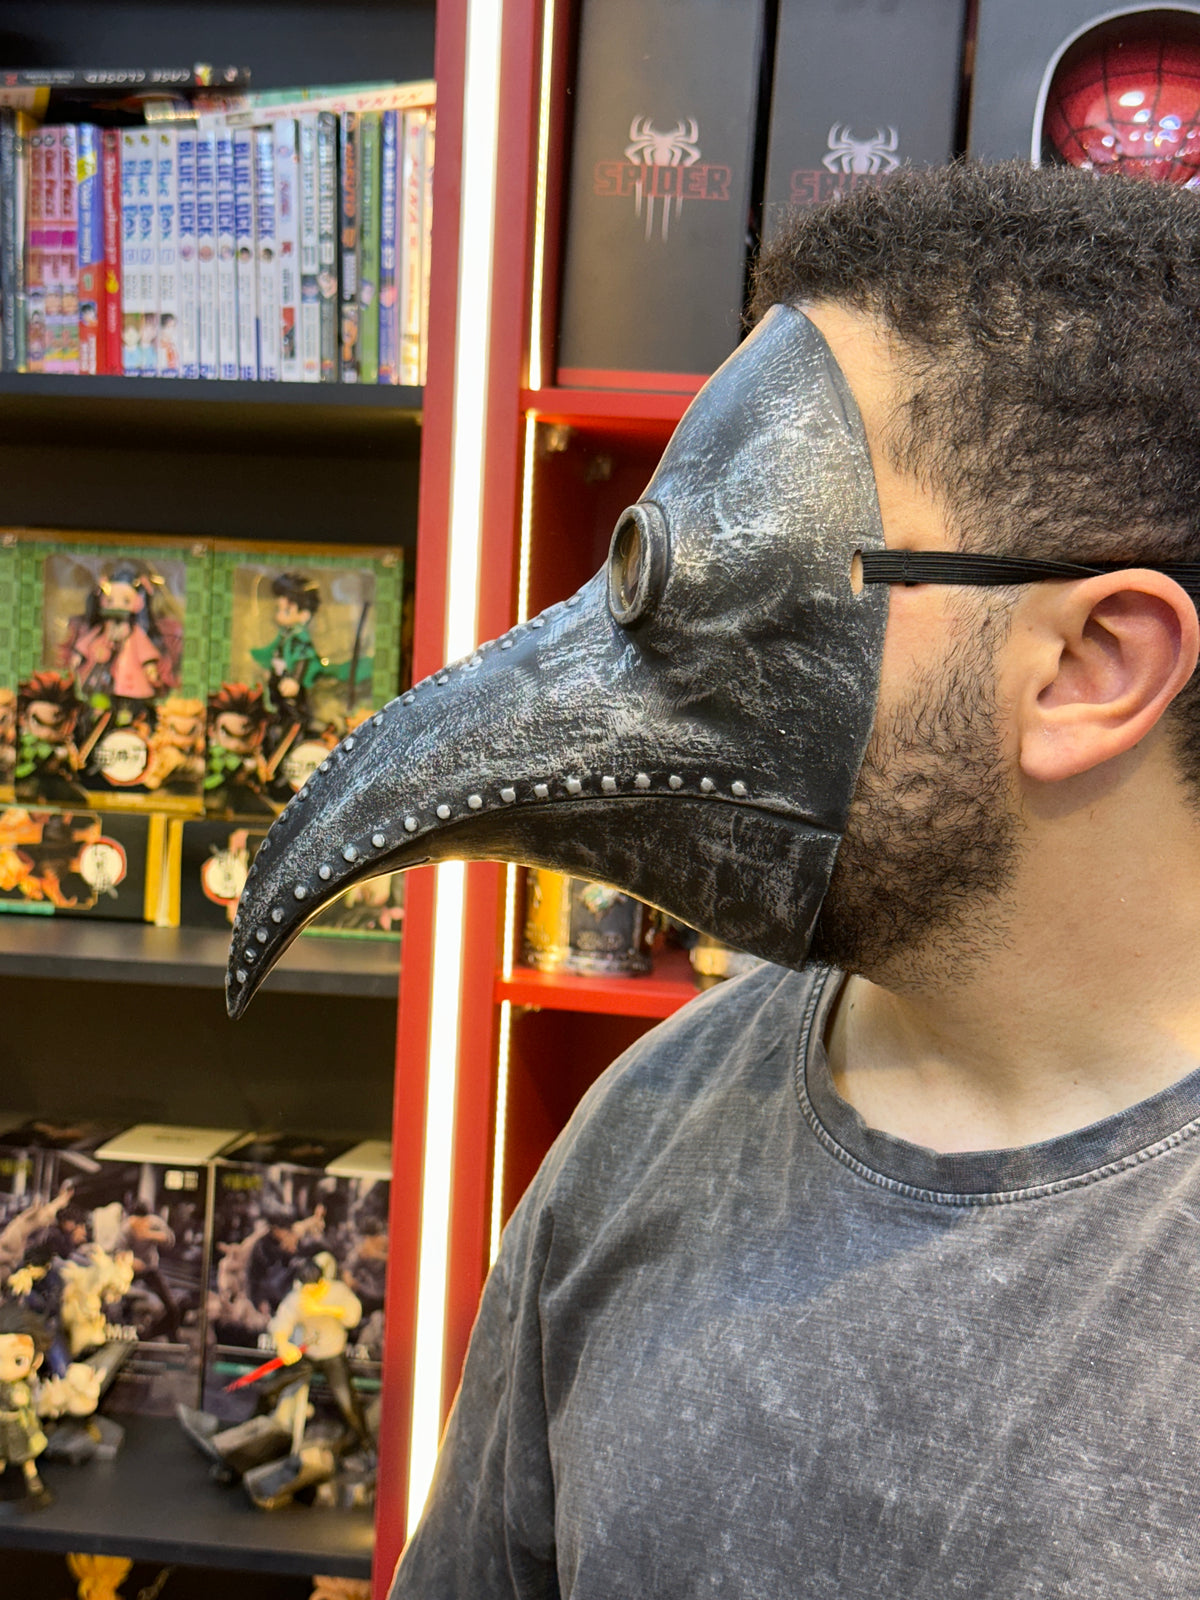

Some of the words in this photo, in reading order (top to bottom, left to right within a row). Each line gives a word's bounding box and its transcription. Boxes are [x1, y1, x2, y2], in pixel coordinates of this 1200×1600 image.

[83, 69, 146, 84] CLOSED
[152, 69, 191, 82] CASE
[123, 160, 136, 197] Blue
[139, 160, 152, 197] Blue
[159, 160, 172, 197] Blue
[179, 141, 193, 188] BLUE
[197, 142, 212, 188] BLUE
[217, 140, 232, 188] BLUE
[234, 142, 249, 189] BLUE
[593, 161, 731, 200] SPIDER
[123, 204, 138, 240] Box
[140, 204, 154, 240] Box
[160, 204, 174, 240] Box
[179, 190, 194, 237] LOCK
[198, 190, 213, 237] LOCK
[219, 189, 233, 237] LOCK
[235, 191, 250, 239] LOCK
[258, 193, 274, 241] LOCK
